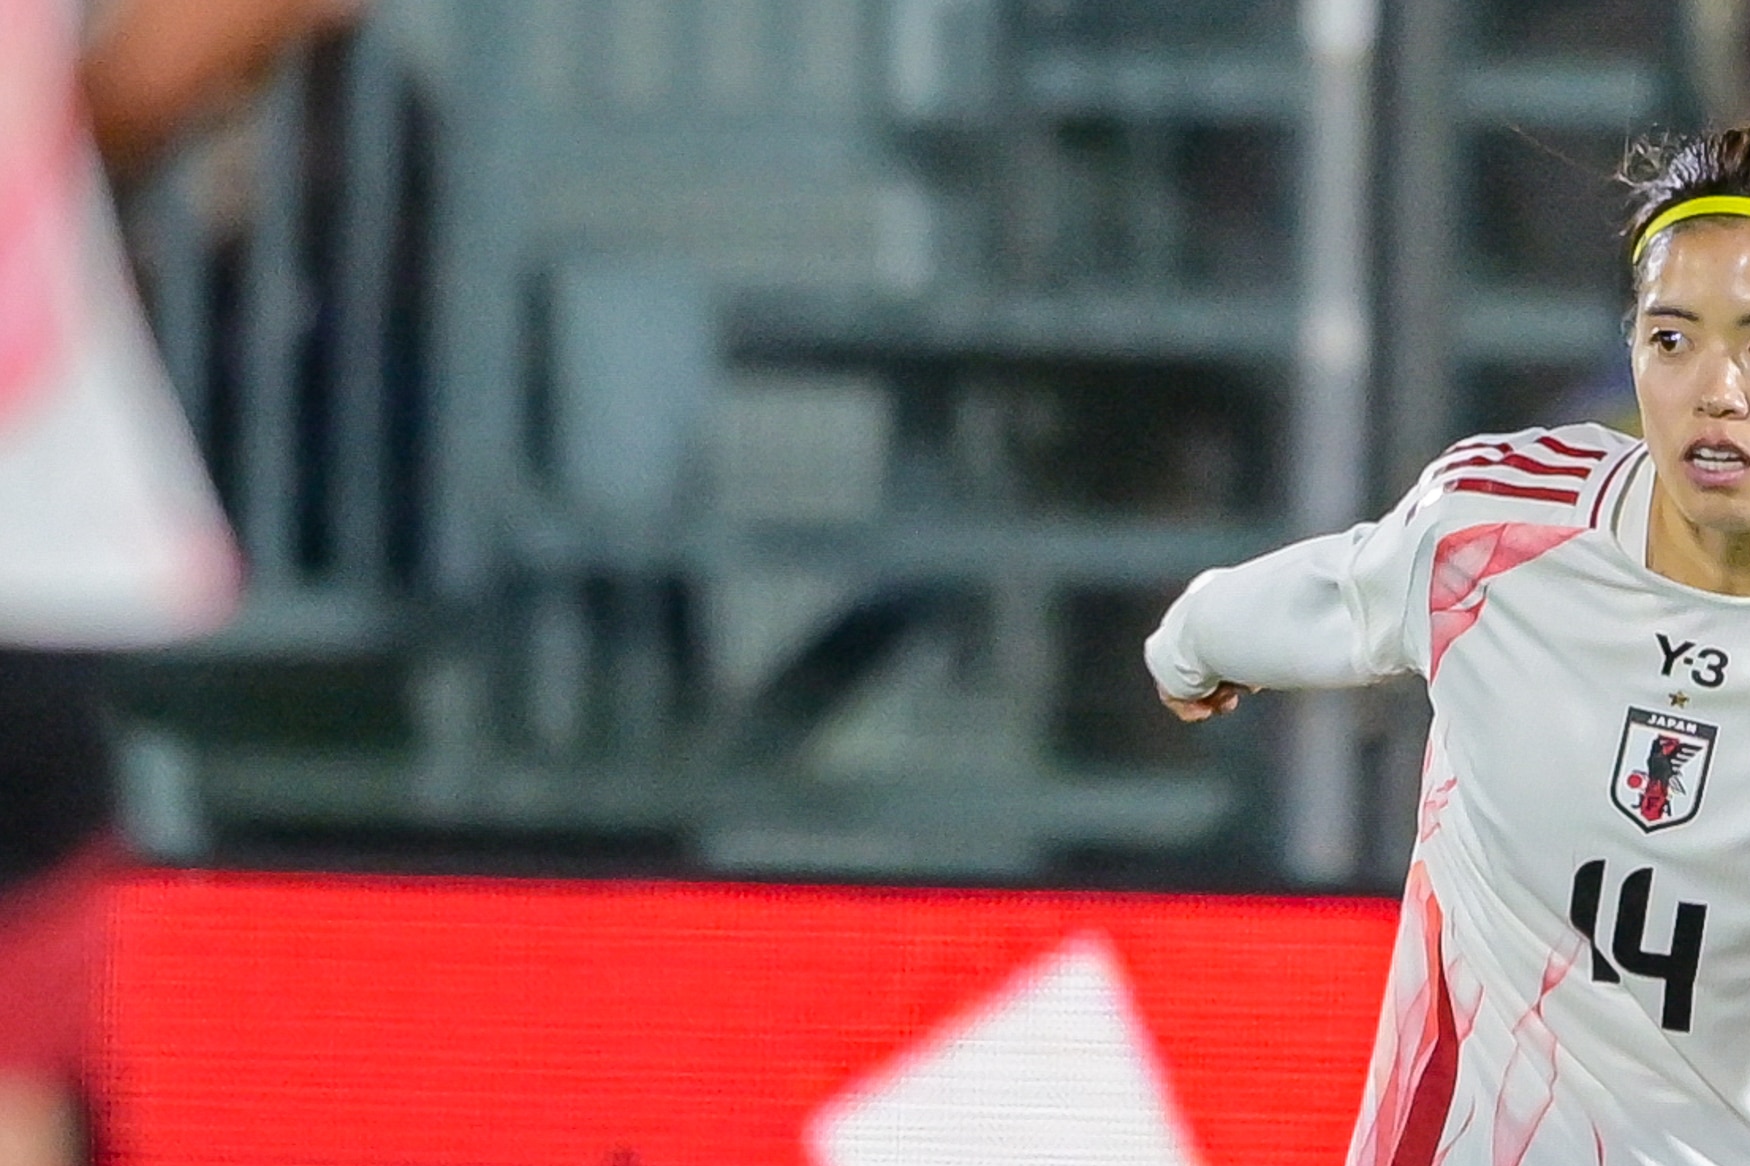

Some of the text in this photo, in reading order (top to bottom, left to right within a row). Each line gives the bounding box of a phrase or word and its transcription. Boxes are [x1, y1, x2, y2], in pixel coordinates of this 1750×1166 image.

[1655, 633, 1729, 688] Y-3
[1647, 714, 1698, 735] JAPAN
[1570, 858, 1708, 1033] 14
